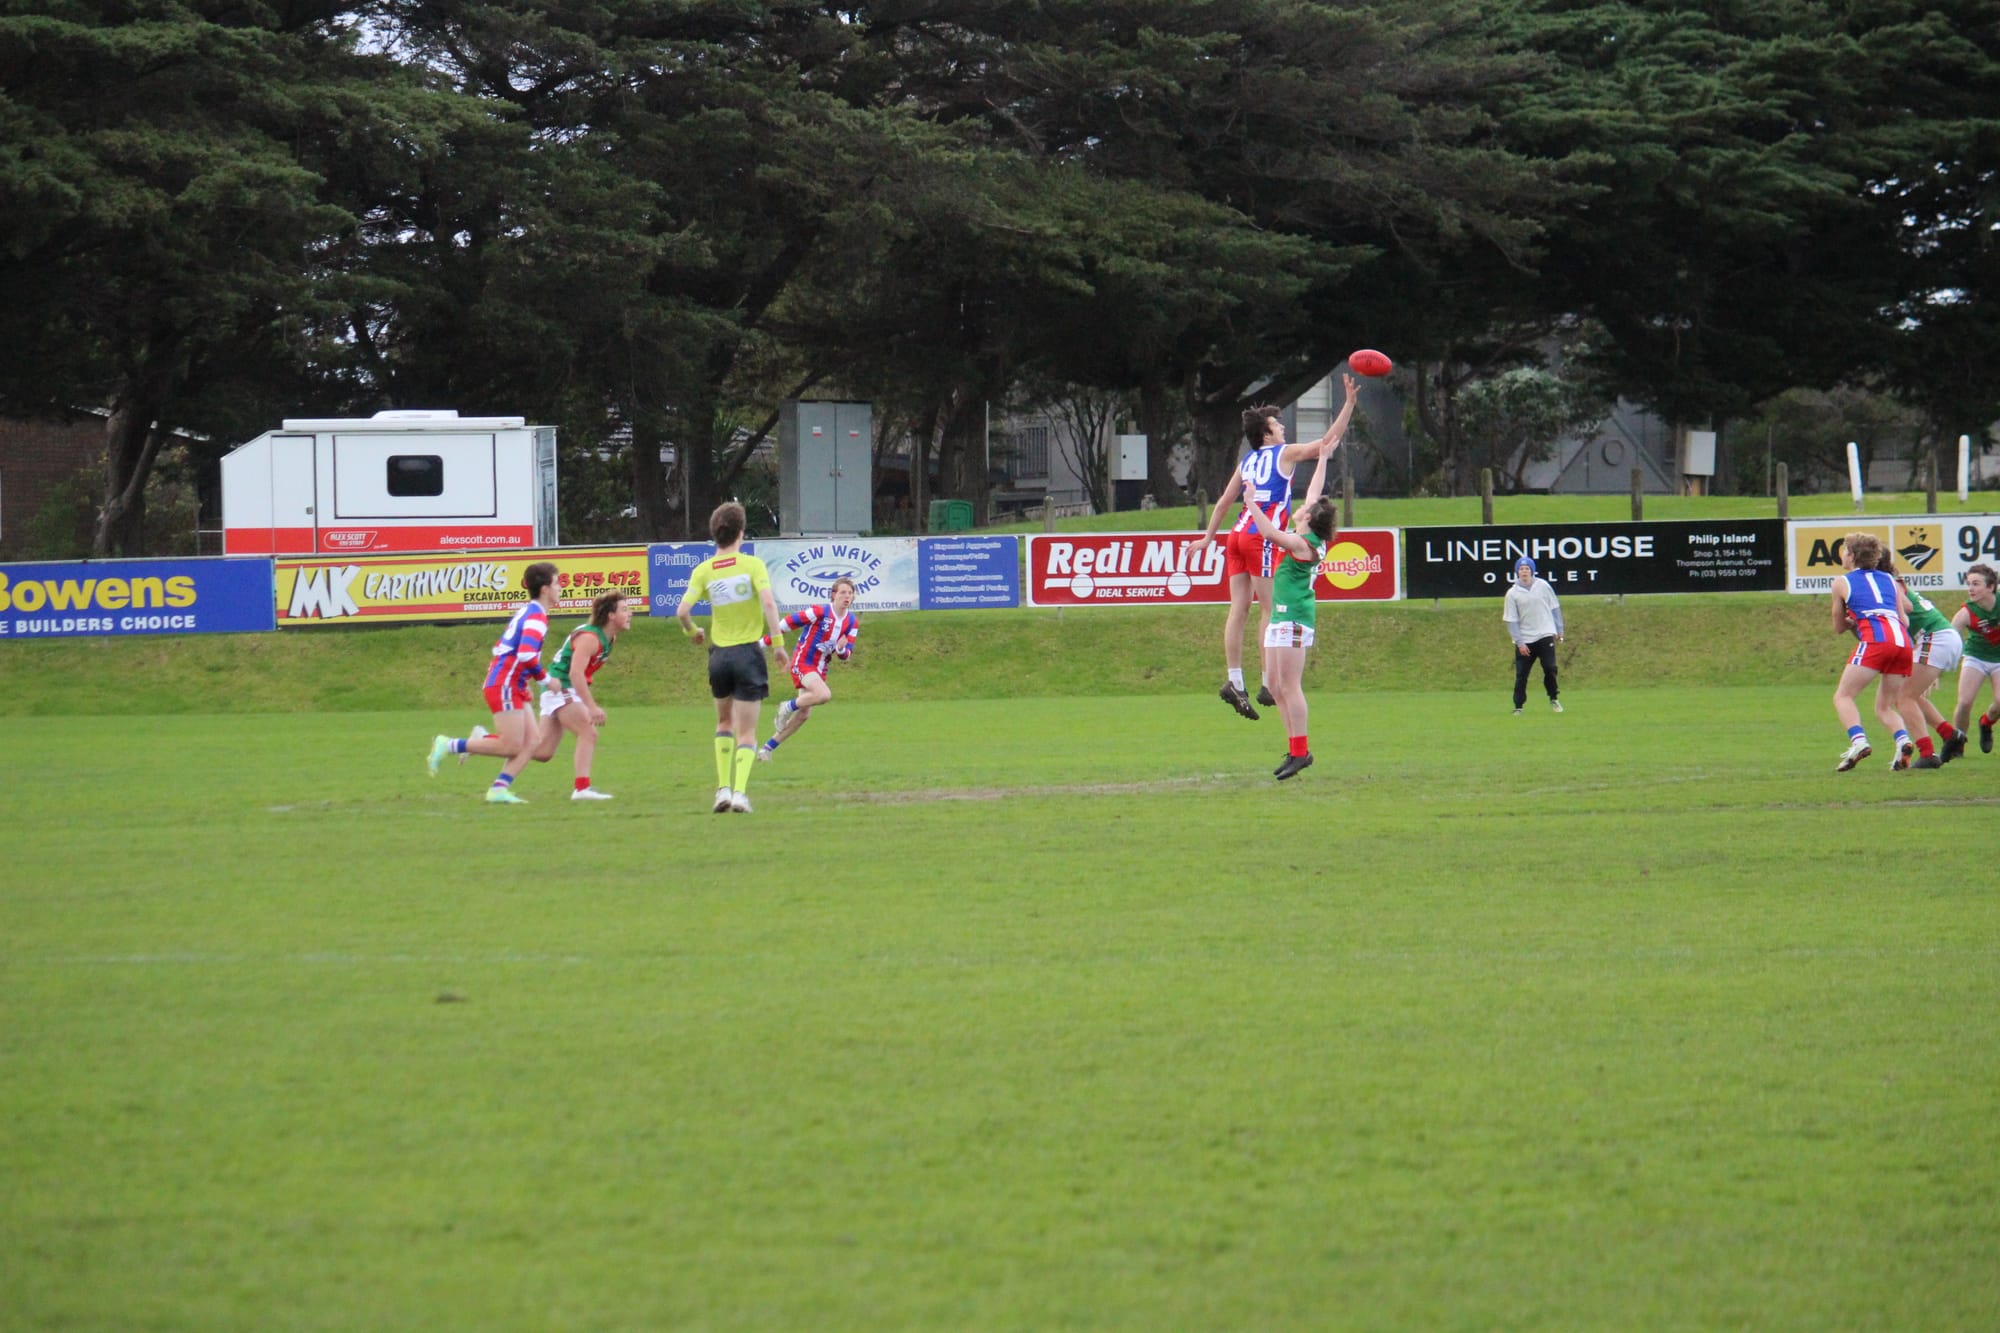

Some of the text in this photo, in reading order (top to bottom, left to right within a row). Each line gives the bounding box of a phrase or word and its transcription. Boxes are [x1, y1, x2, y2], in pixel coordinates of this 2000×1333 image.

[1242, 450, 1273, 486] 40
[440, 535, 521, 545] alexscott.com.au
[1688, 533, 1756, 545] Philip Island
[1047, 541, 1134, 575] Redi
[1425, 536, 1655, 563] LINENHOUSE
[1693, 550, 1713, 558] Shop
[655, 553, 700, 568] Phillip
[786, 544, 882, 573] NEW WAVE
[1676, 559, 1715, 567] Thompson
[573, 572, 606, 587] 975
[608, 570, 641, 586] 472
[1483, 569, 1598, 584] OULET
[288, 562, 509, 619] MK EARTHWORKS
[790, 575, 880, 599] CONCING
[1096, 586, 1166, 598] IDEAL SERVICE
[1865, 572, 1884, 604] 1
[463, 590, 527, 602] EXCAVATORS
[15, 617, 114, 633] BUILDERS
[120, 615, 196, 631] CHOICE
